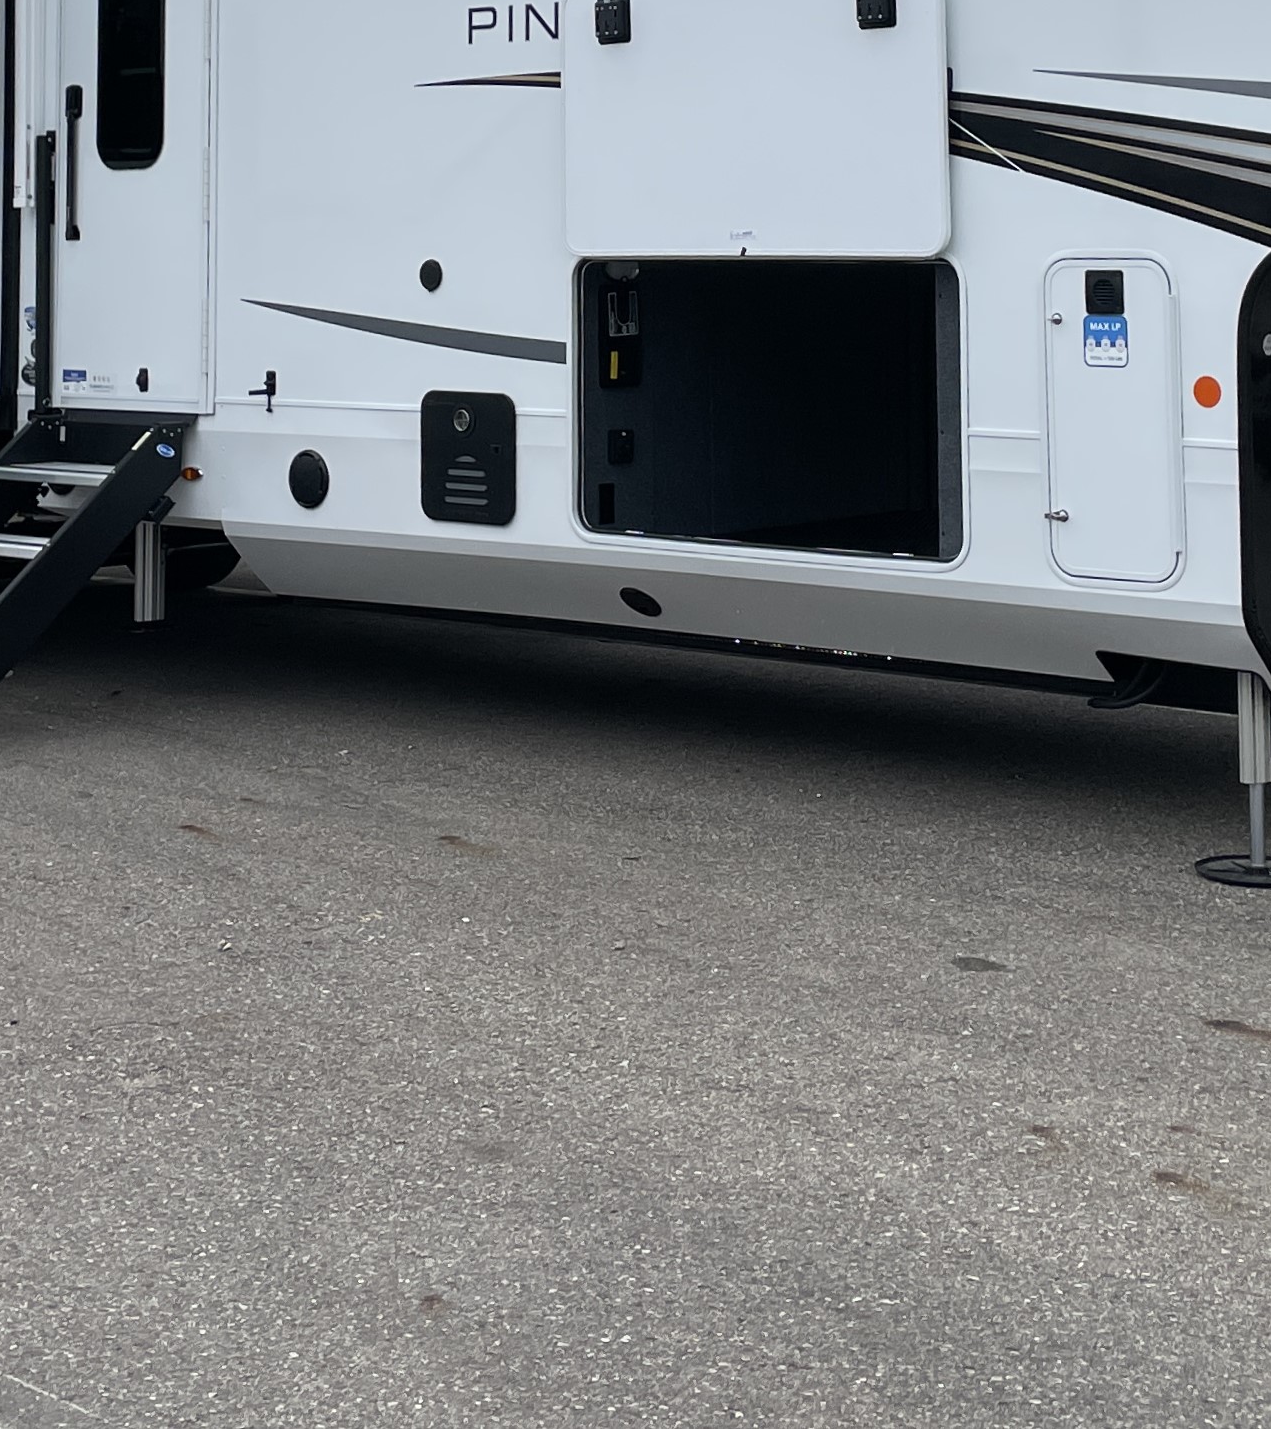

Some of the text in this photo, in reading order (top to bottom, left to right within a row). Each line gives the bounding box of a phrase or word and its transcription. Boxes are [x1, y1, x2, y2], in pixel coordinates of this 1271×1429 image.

[468, 1, 559, 45] PIN
[1090, 322, 1122, 331] MAX LP
